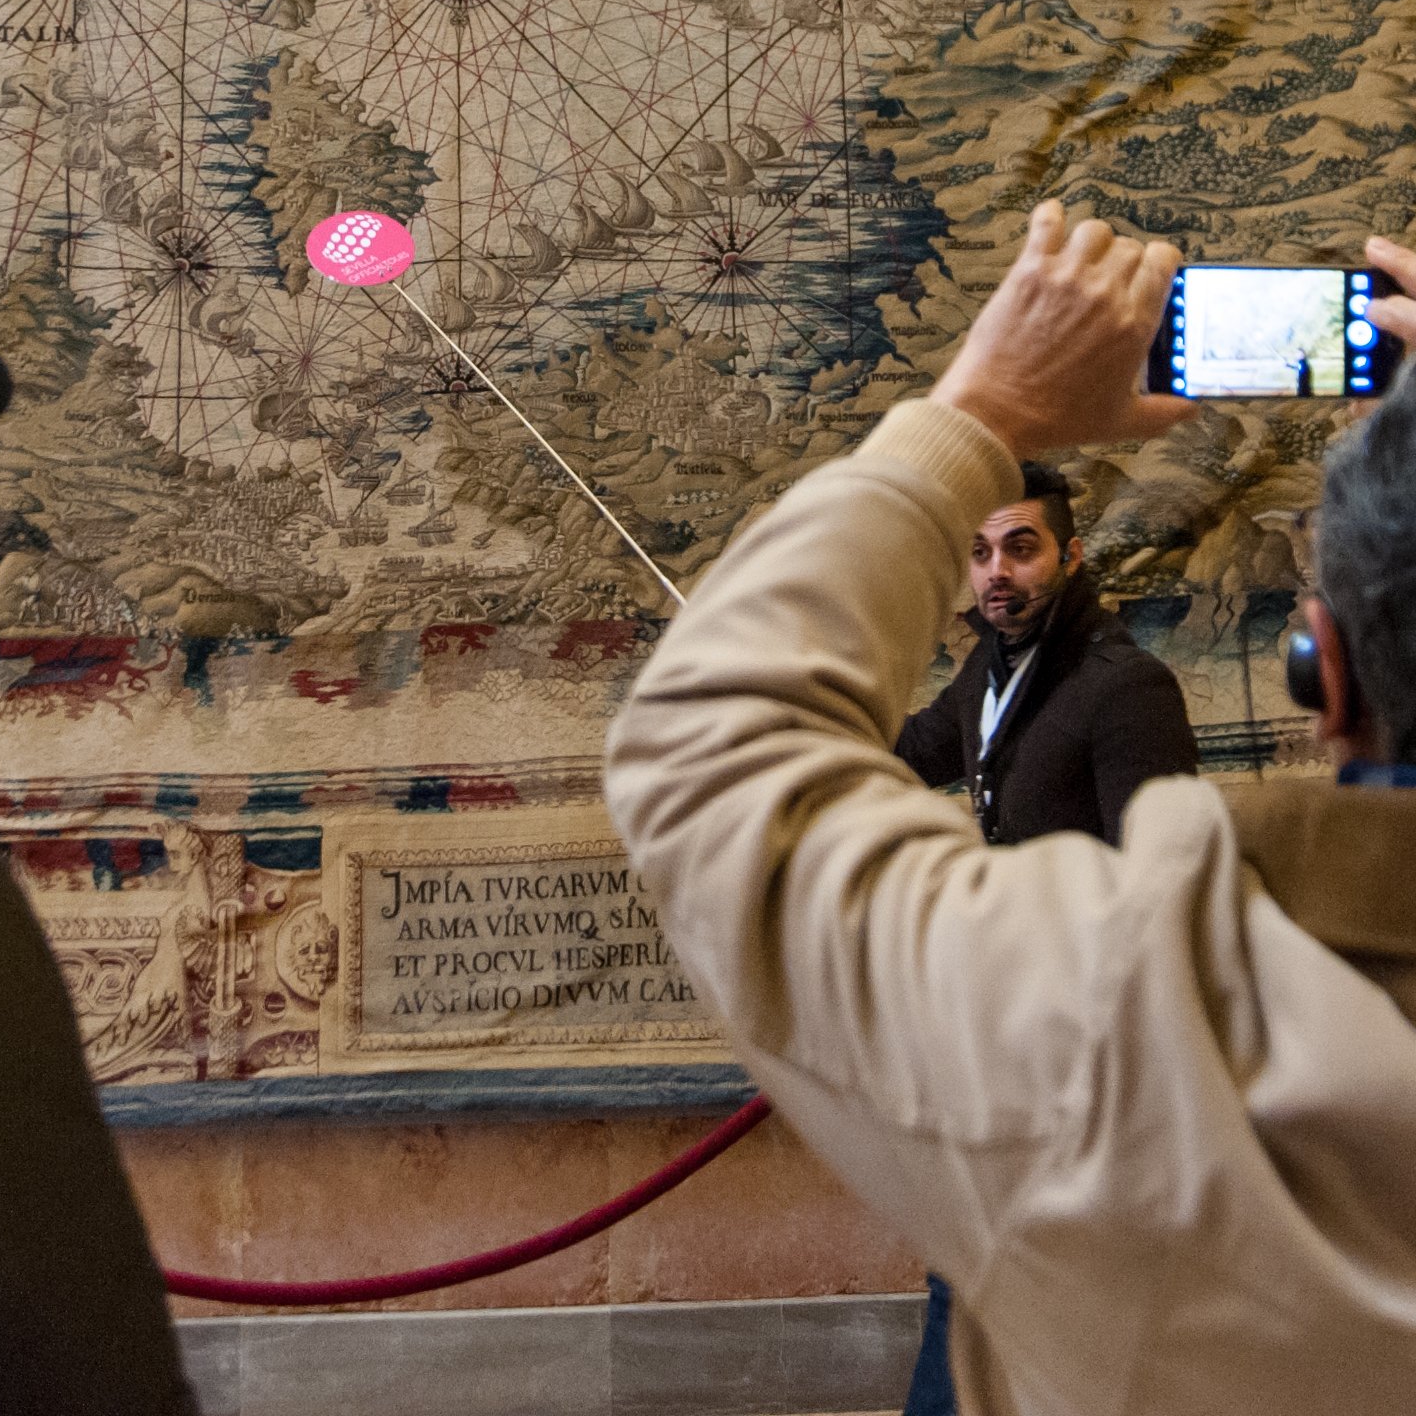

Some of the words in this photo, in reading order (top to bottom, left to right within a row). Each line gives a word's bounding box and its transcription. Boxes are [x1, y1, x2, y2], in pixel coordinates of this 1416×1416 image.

[396, 917, 479, 940] ARMA
[393, 954, 426, 978] ET
[434, 949, 544, 977] PROCVL
